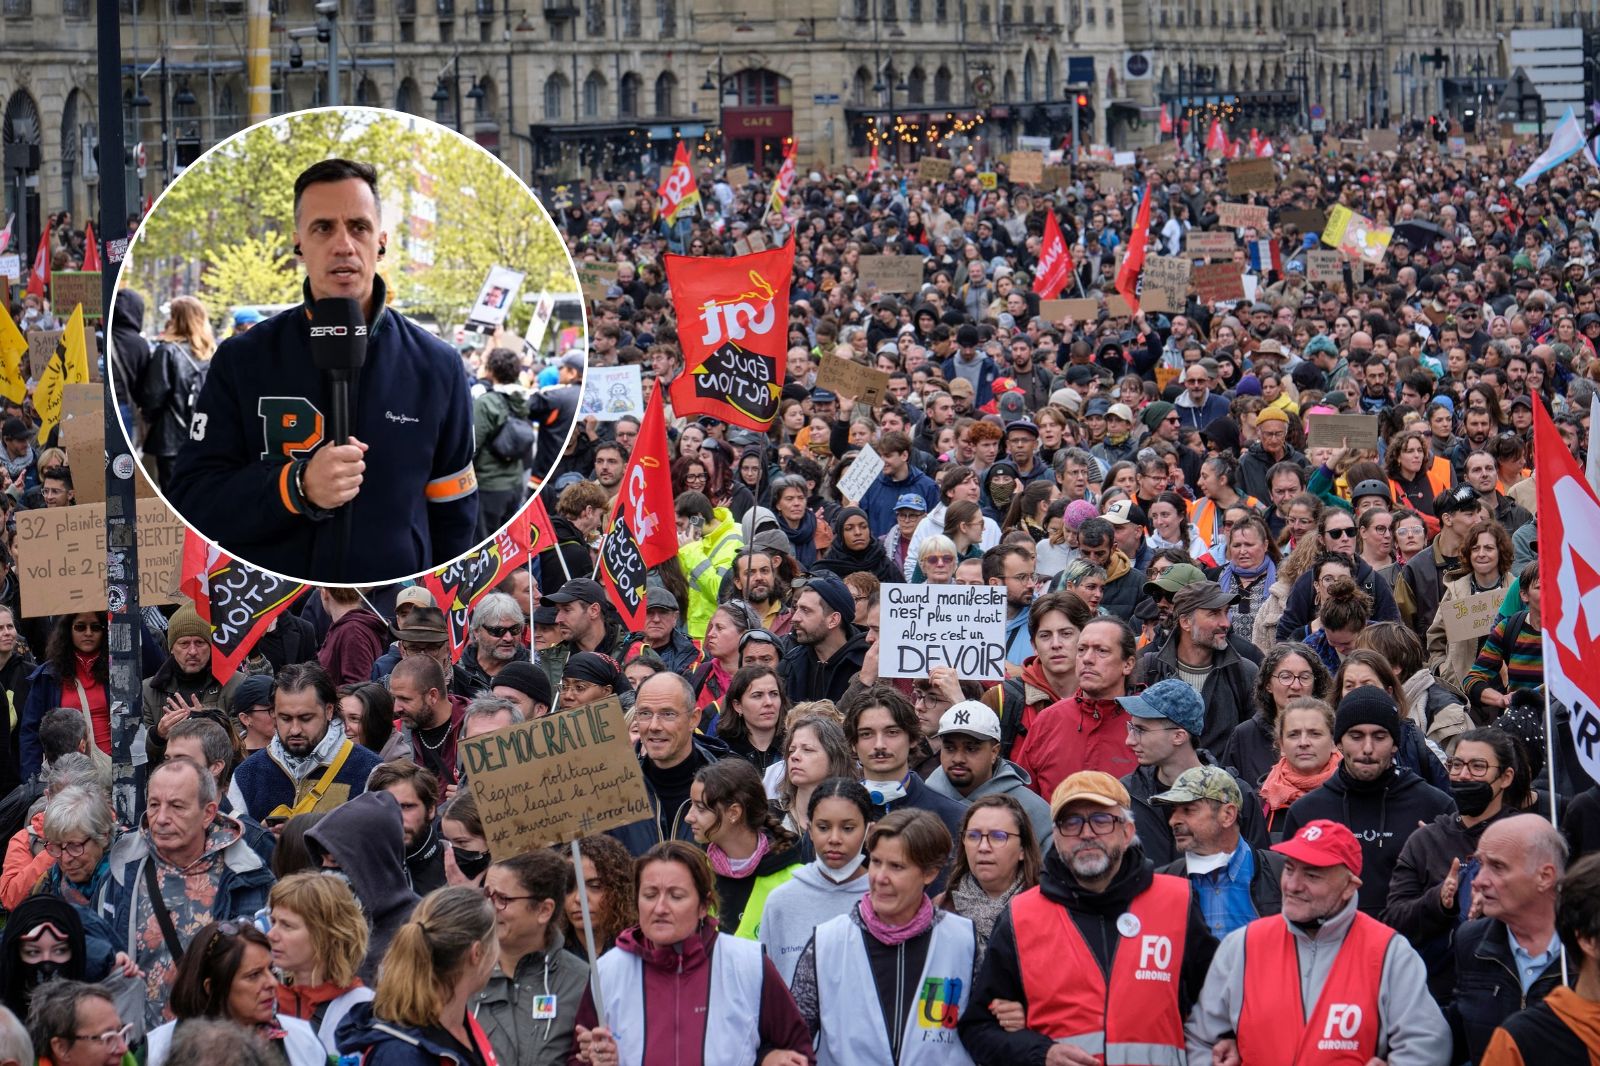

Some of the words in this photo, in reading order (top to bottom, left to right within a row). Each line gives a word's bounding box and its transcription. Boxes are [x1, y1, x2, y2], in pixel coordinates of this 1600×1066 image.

[310, 326, 347, 336] ZERO
[20, 516, 48, 541] 32
[27, 559, 51, 579] vol
[59, 556, 76, 577] de
[81, 559, 94, 575] 2
[888, 586, 929, 604] Quand
[937, 586, 1007, 606] manifester
[890, 604, 924, 619] n'est
[928, 605, 952, 627] plus
[957, 614, 970, 622] un
[974, 609, 1002, 623] droit
[902, 620, 936, 641] Alors
[941, 626, 967, 640] c'est
[970, 631, 984, 640] un
[953, 709, 971, 725] NY
[474, 780, 534, 806] Régime
[539, 762, 608, 792] politique
[485, 807, 519, 825] dans
[523, 790, 564, 814] lequel
[571, 784, 586, 801] le
[592, 766, 636, 799] peuple
[491, 828, 510, 842] est
[1140, 935, 1172, 970] FO
[1135, 969, 1171, 982] GIRONDE
[1323, 1004, 1362, 1039] FO
[1318, 1040, 1360, 1050] GIRONDE
